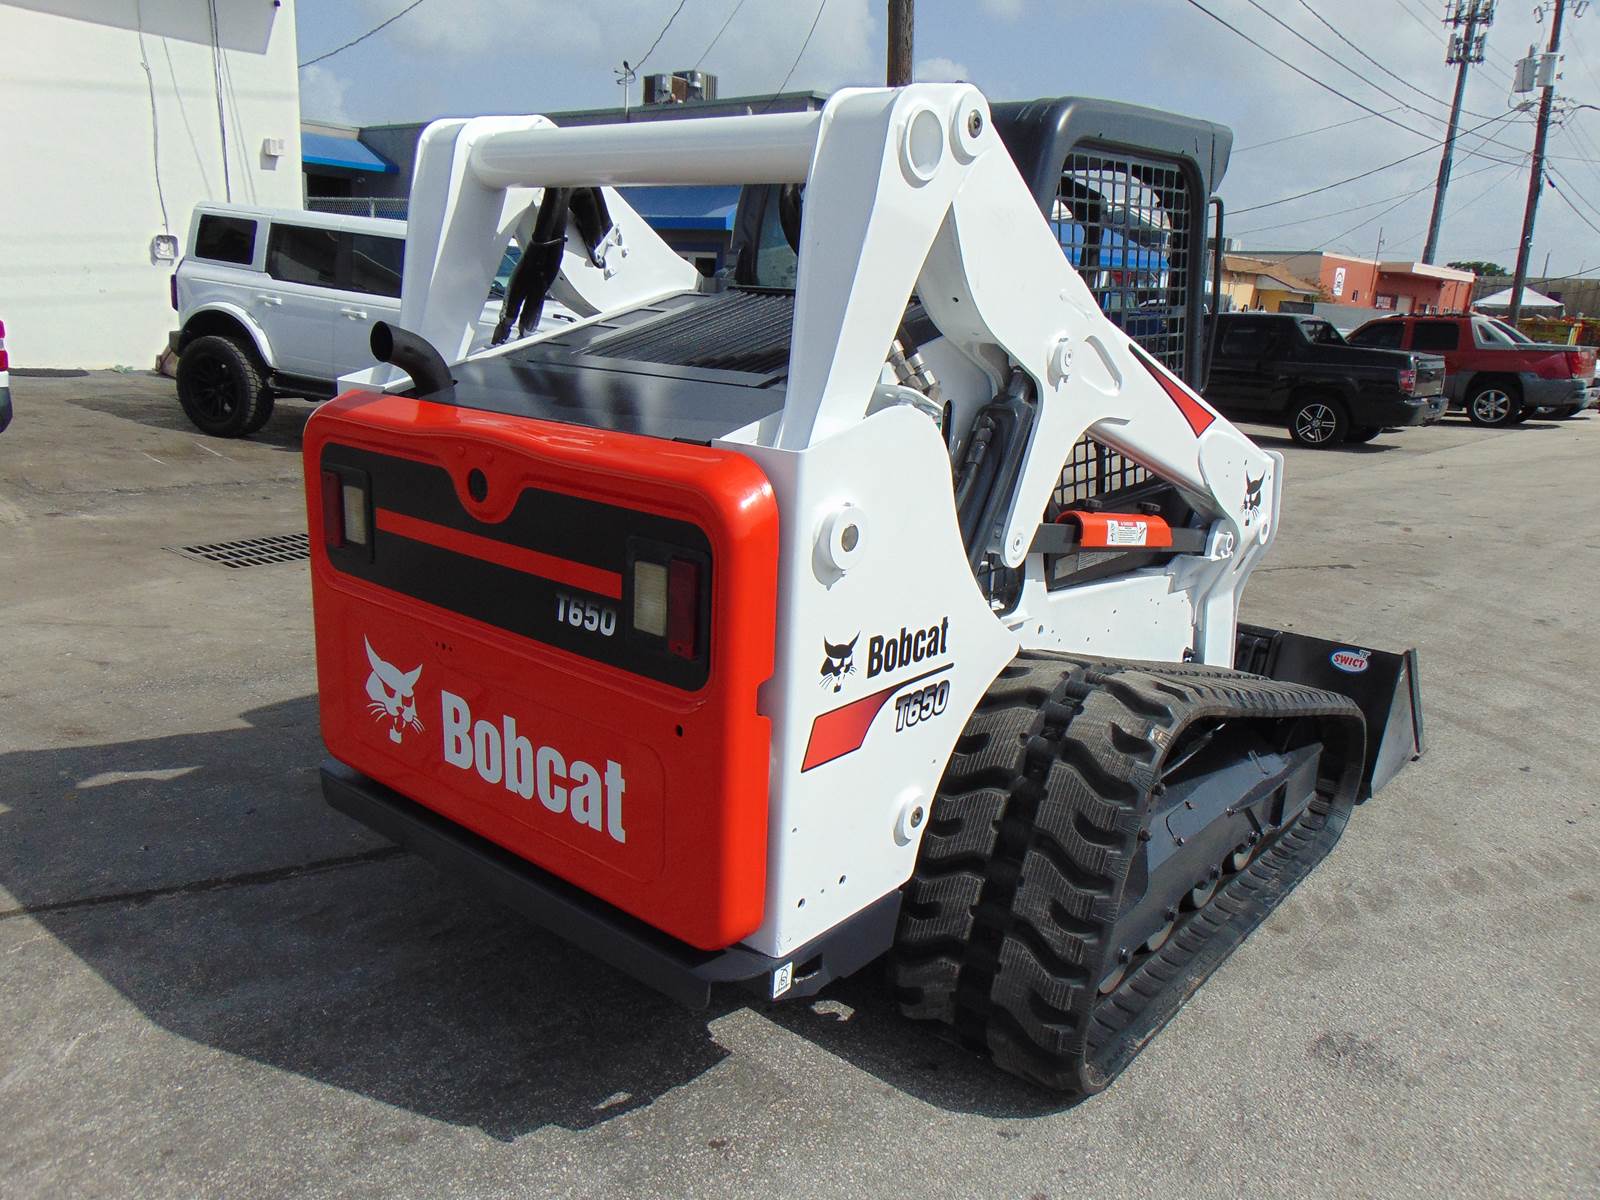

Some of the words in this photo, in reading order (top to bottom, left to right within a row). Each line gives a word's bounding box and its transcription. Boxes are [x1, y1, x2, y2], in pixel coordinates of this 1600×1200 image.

[554, 591, 617, 637] T650
[867, 616, 949, 679] Bobcat
[1334, 654, 1364, 668] SWICT
[895, 680, 951, 733] T650
[441, 689, 627, 845] Bobcat
